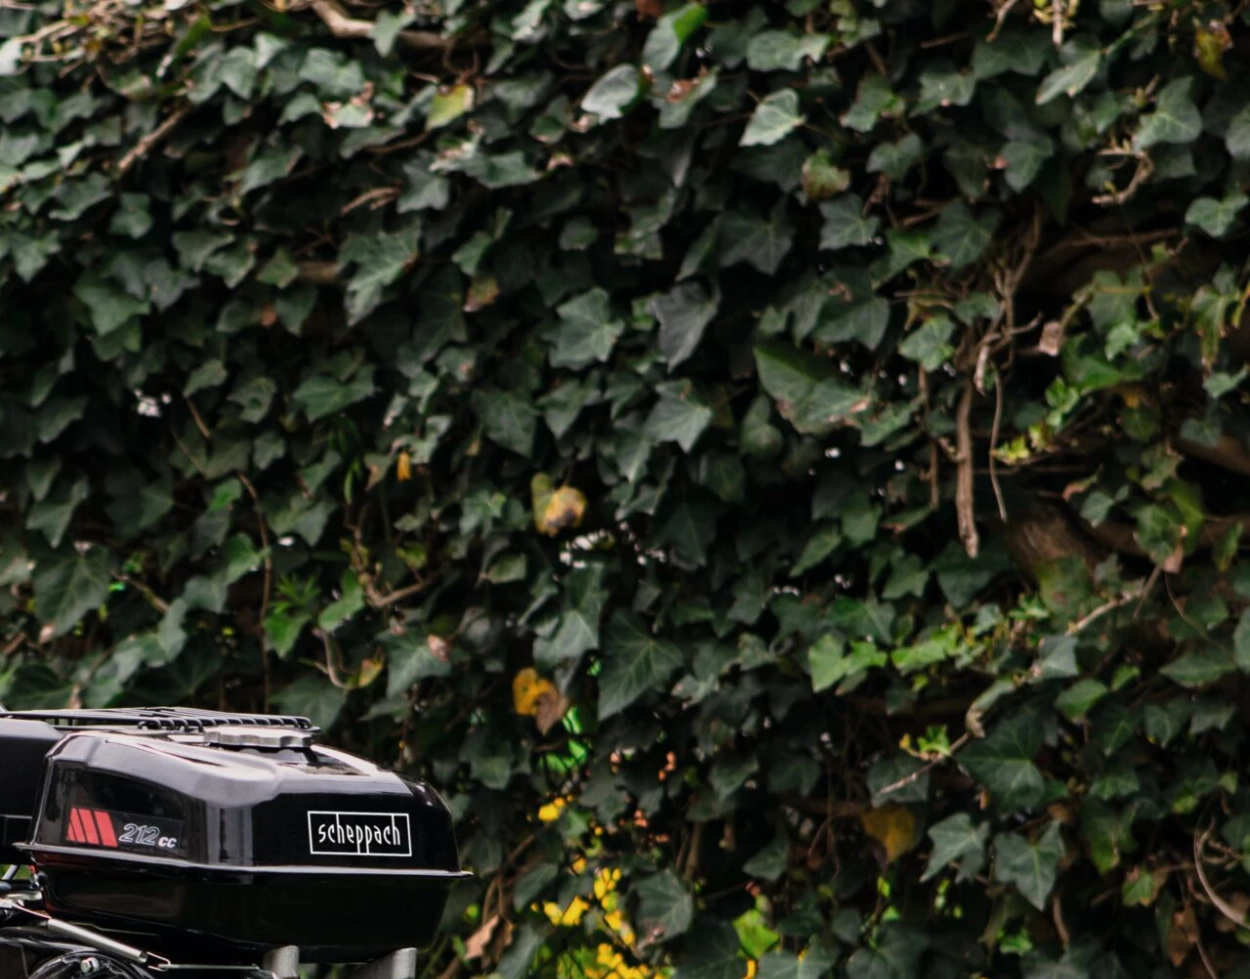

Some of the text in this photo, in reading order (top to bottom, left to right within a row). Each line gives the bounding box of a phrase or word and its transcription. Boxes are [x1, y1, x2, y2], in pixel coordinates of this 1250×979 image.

[118, 823, 178, 849] 212 cc
[317, 812, 401, 854] scheppach
